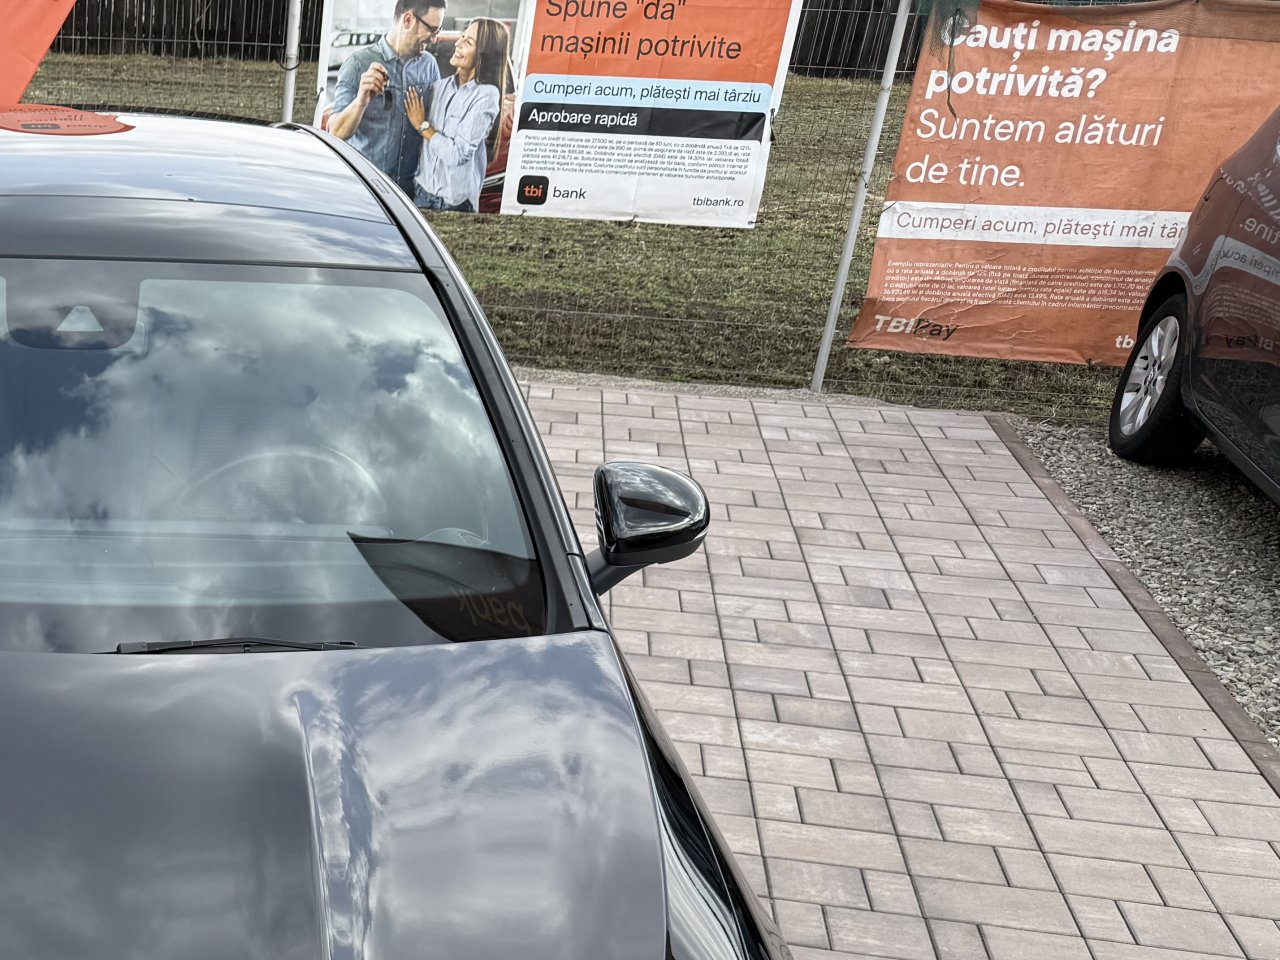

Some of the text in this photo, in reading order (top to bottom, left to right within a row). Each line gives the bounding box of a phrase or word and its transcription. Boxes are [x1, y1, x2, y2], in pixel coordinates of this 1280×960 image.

[545, 0, 686, 22] Spune "da"
[541, 31, 742, 60] mașinii potrivite
[533, 80, 762, 103] Cumperi acum, plătești mai târziu
[925, 64, 1107, 99] potrivită?
[528, 108, 638, 127] Aprobare rapidă
[917, 109, 1166, 146] Suntem alături
[905, 154, 1025, 187] de tine.
[523, 184, 587, 200] tbi bank
[692, 196, 744, 208] tbibank.ro
[896, 211, 978, 232] Cumperi
[981, 219, 1037, 236] acum,
[1119, 222, 1154, 239] mai
